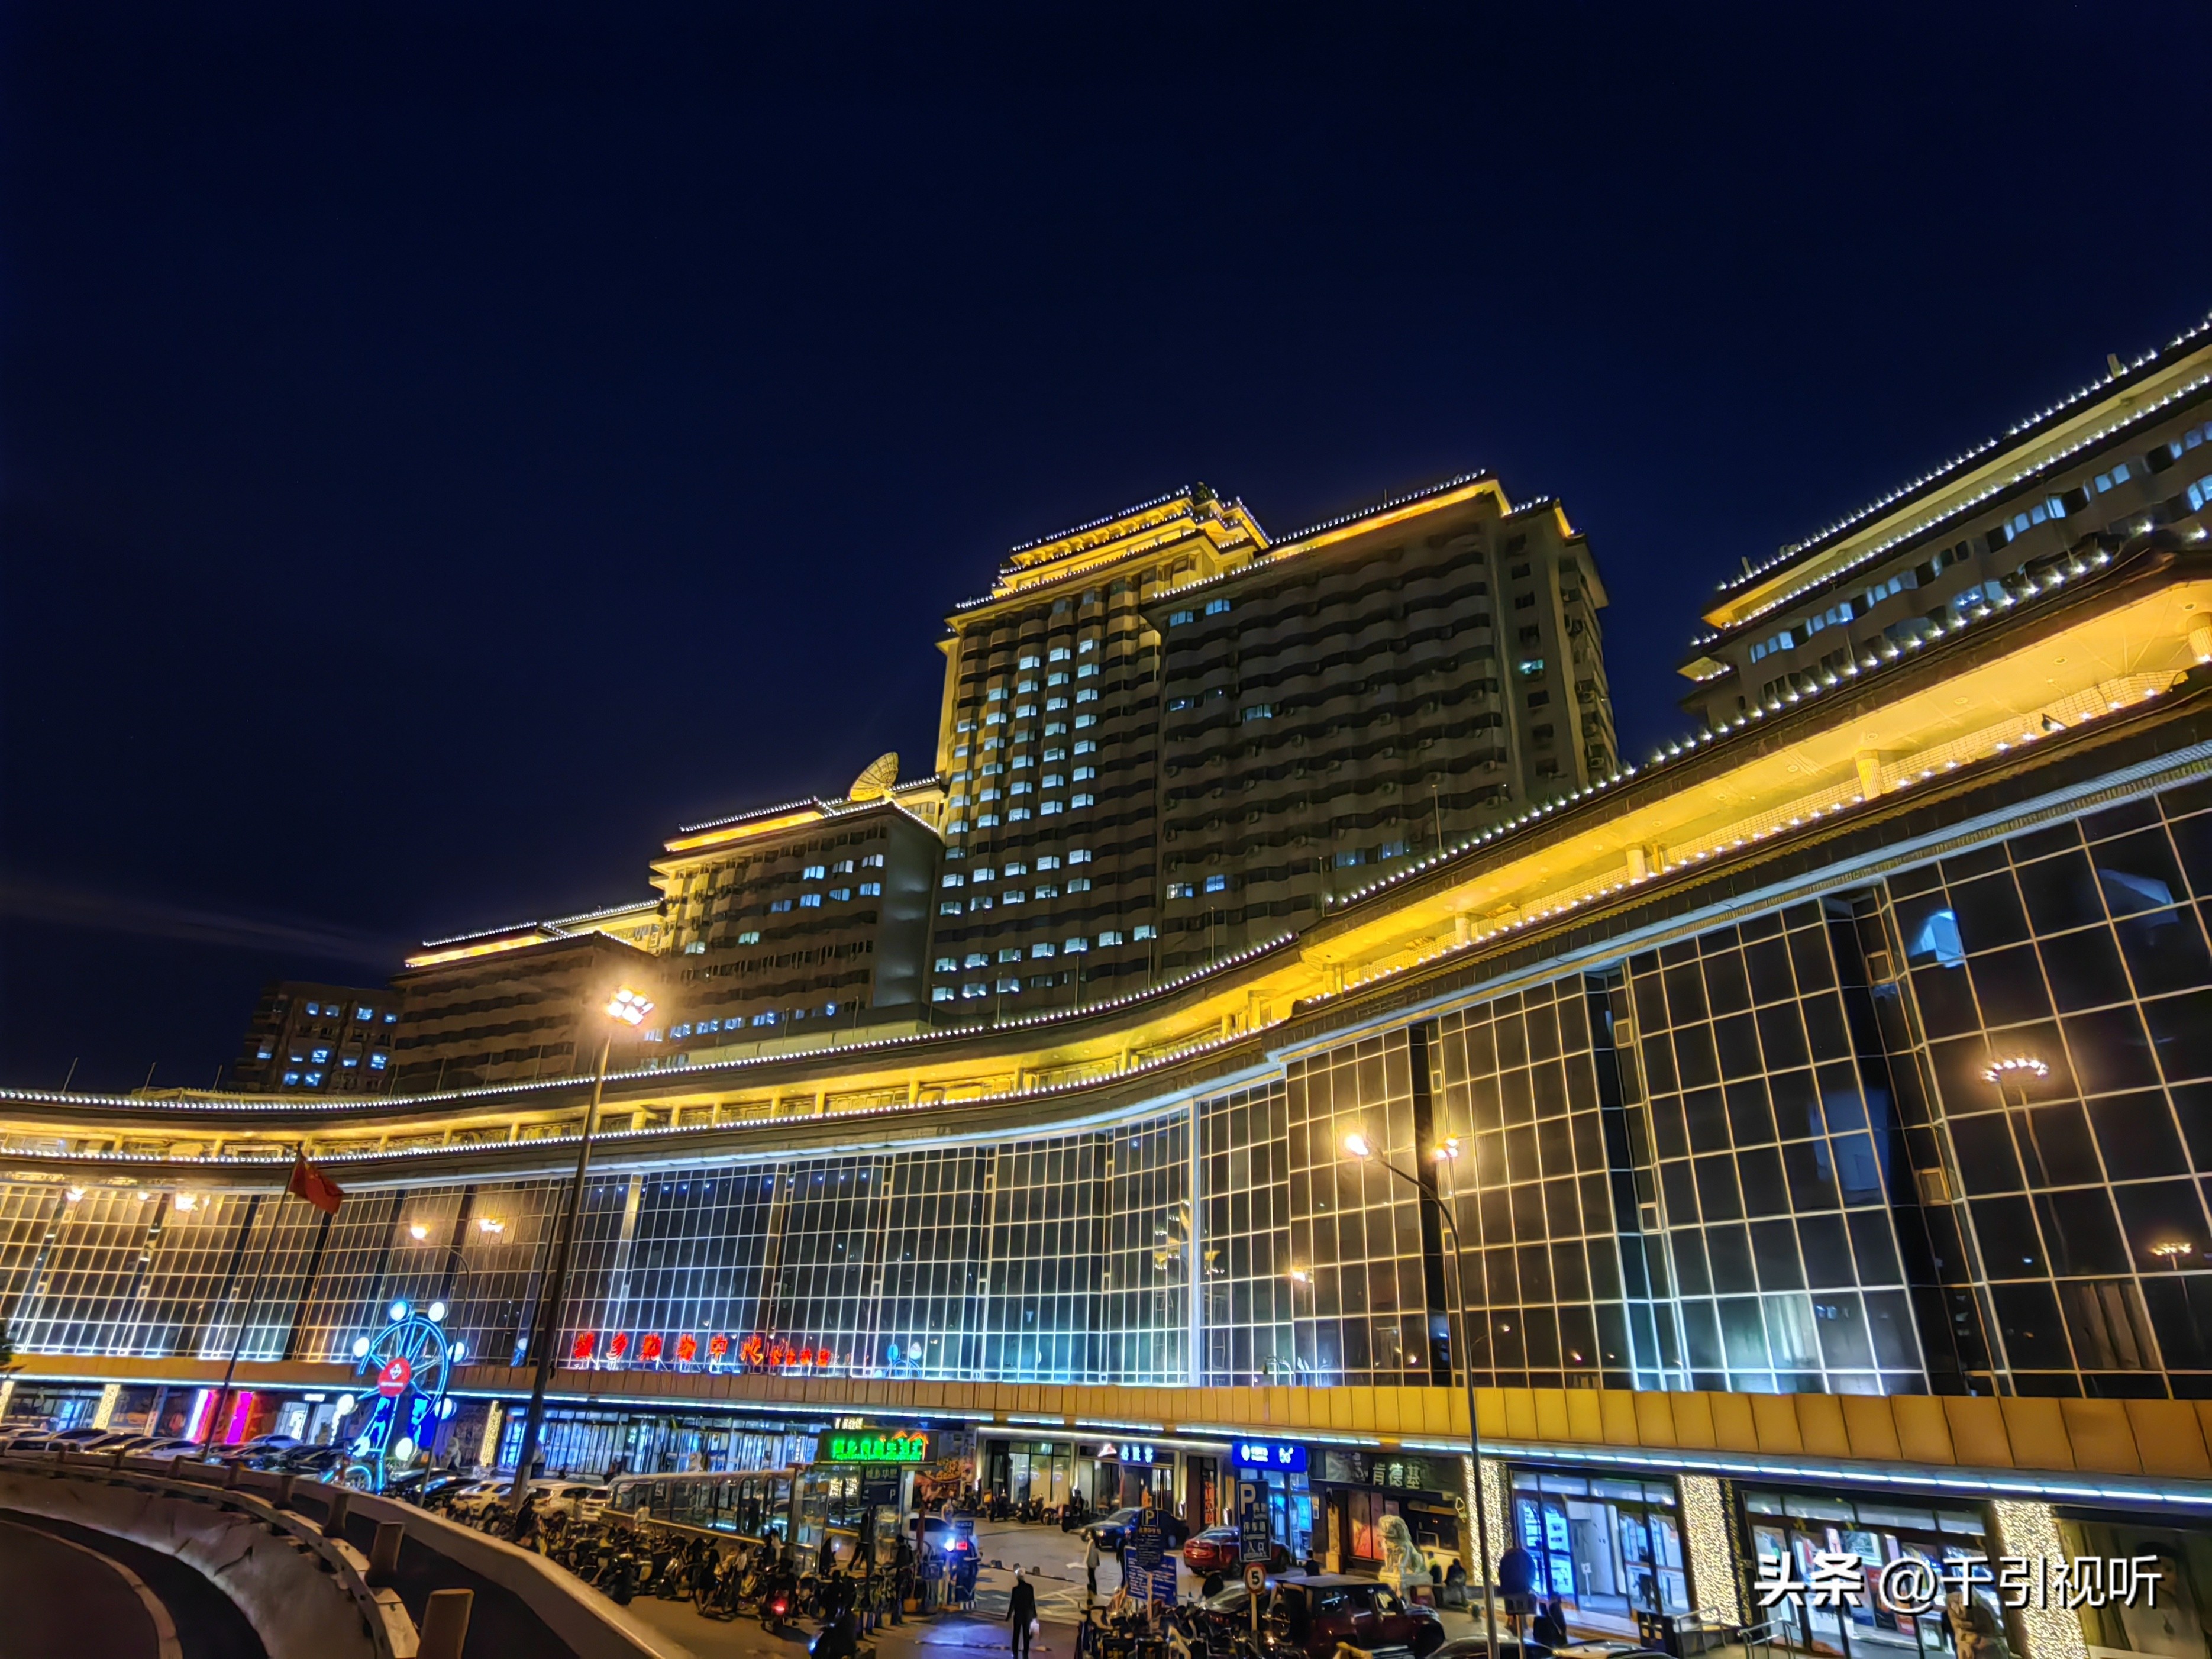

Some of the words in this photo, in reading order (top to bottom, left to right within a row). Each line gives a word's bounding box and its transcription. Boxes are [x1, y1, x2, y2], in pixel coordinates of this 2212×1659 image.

[1373, 1461, 1421, 1490] 肯德基
[1240, 1483, 1257, 1515] P
[1145, 1510, 1155, 1525] P
[1251, 1570, 1260, 1586] 5
